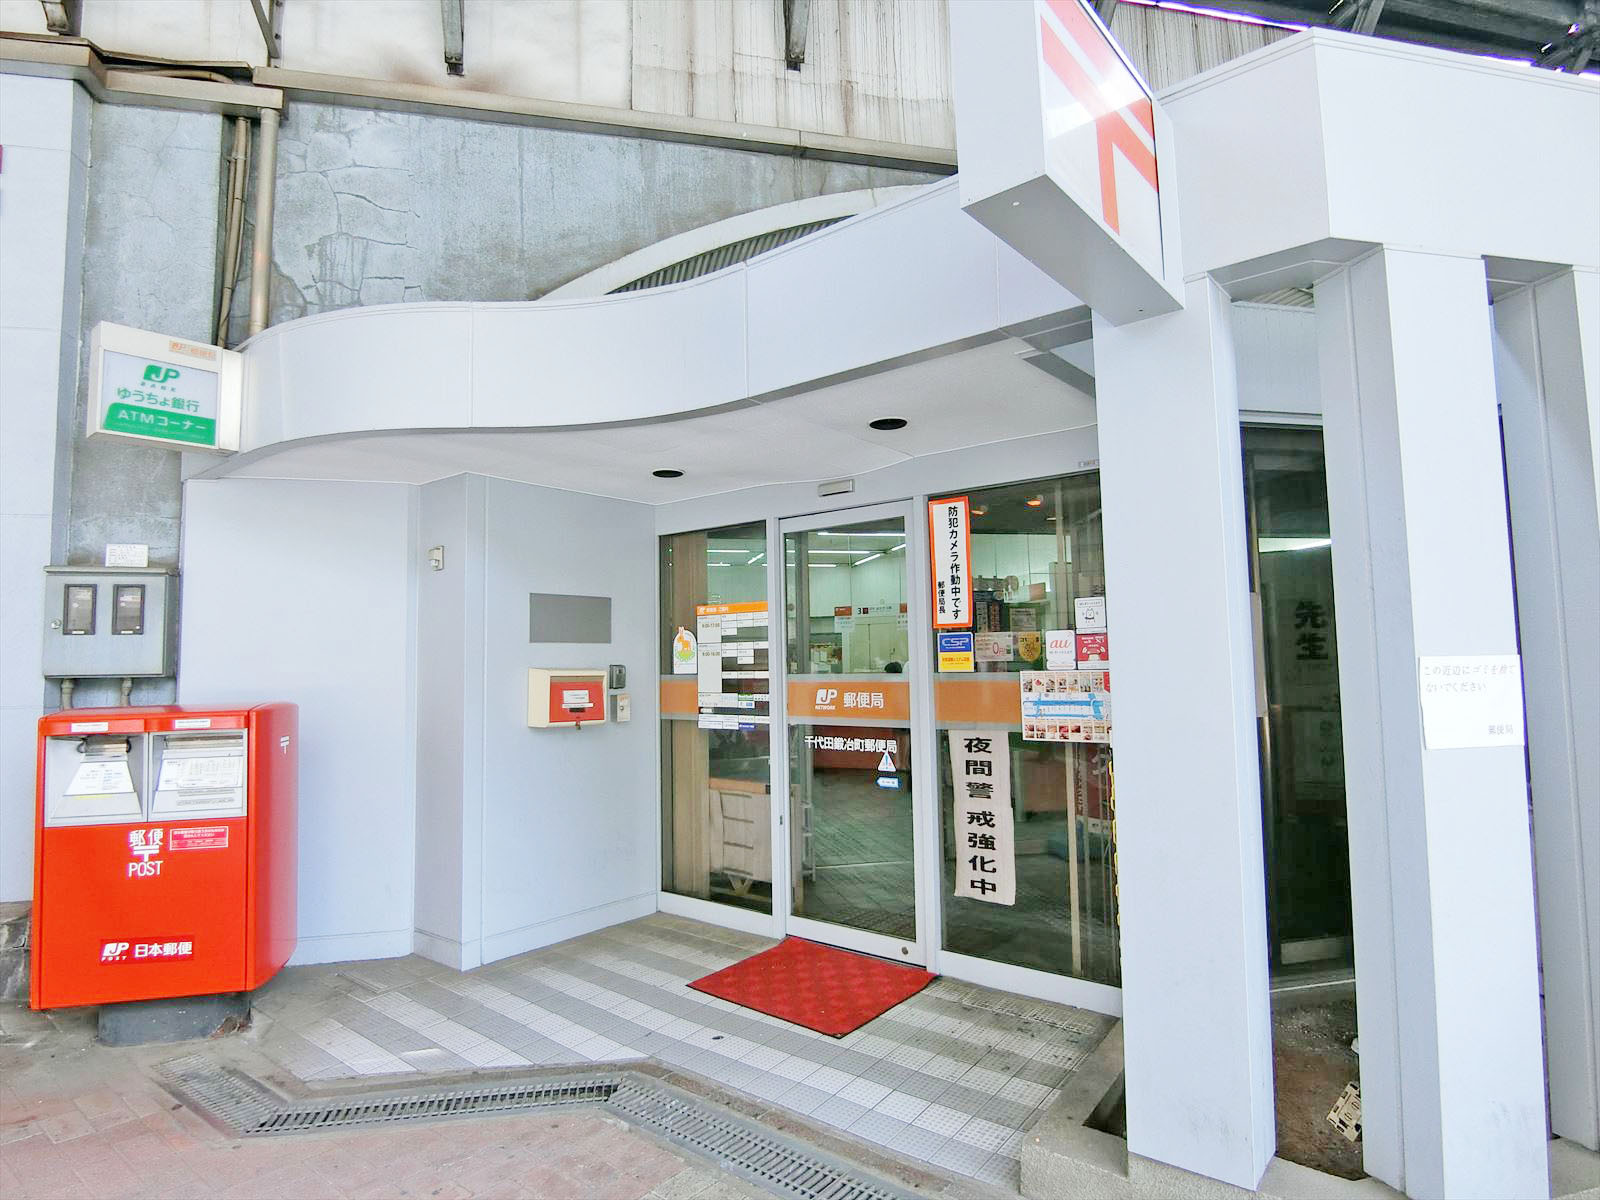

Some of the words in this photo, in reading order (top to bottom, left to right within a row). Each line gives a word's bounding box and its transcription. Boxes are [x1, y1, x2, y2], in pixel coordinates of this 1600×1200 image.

[117, 387, 200, 413] ゆうちょ銀行
[118, 409, 207, 430] ATMコーナー
[948, 505, 962, 620] 防犯カメラ作動中です
[938, 580, 946, 614] 郵便局長
[942, 637, 969, 646] CSP
[1050, 640, 1072, 649] au
[843, 692, 884, 709] 郵便局
[963, 737, 997, 895] 夜間警戒強化中
[129, 828, 163, 847] 郵便
[128, 860, 163, 878] POST
[135, 941, 193, 958] 日本郵便
